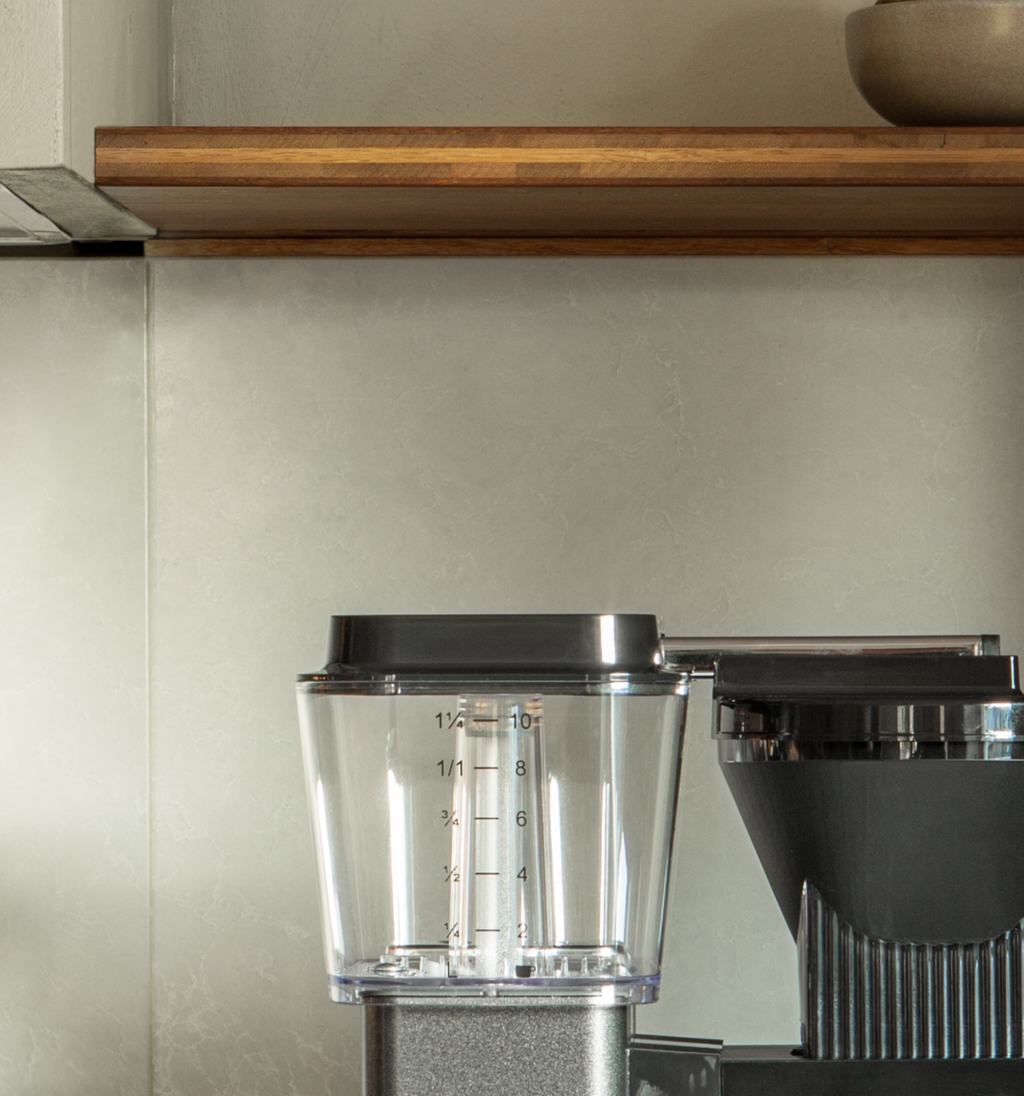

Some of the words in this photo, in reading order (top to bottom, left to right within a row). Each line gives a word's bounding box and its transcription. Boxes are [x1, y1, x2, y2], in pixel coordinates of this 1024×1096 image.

[510, 713, 531, 729] 10
[437, 760, 463, 776] 1/1
[515, 760, 526, 776] 8
[516, 811, 527, 827] 6
[517, 866, 527, 882] 4
[517, 923, 528, 938] 2
